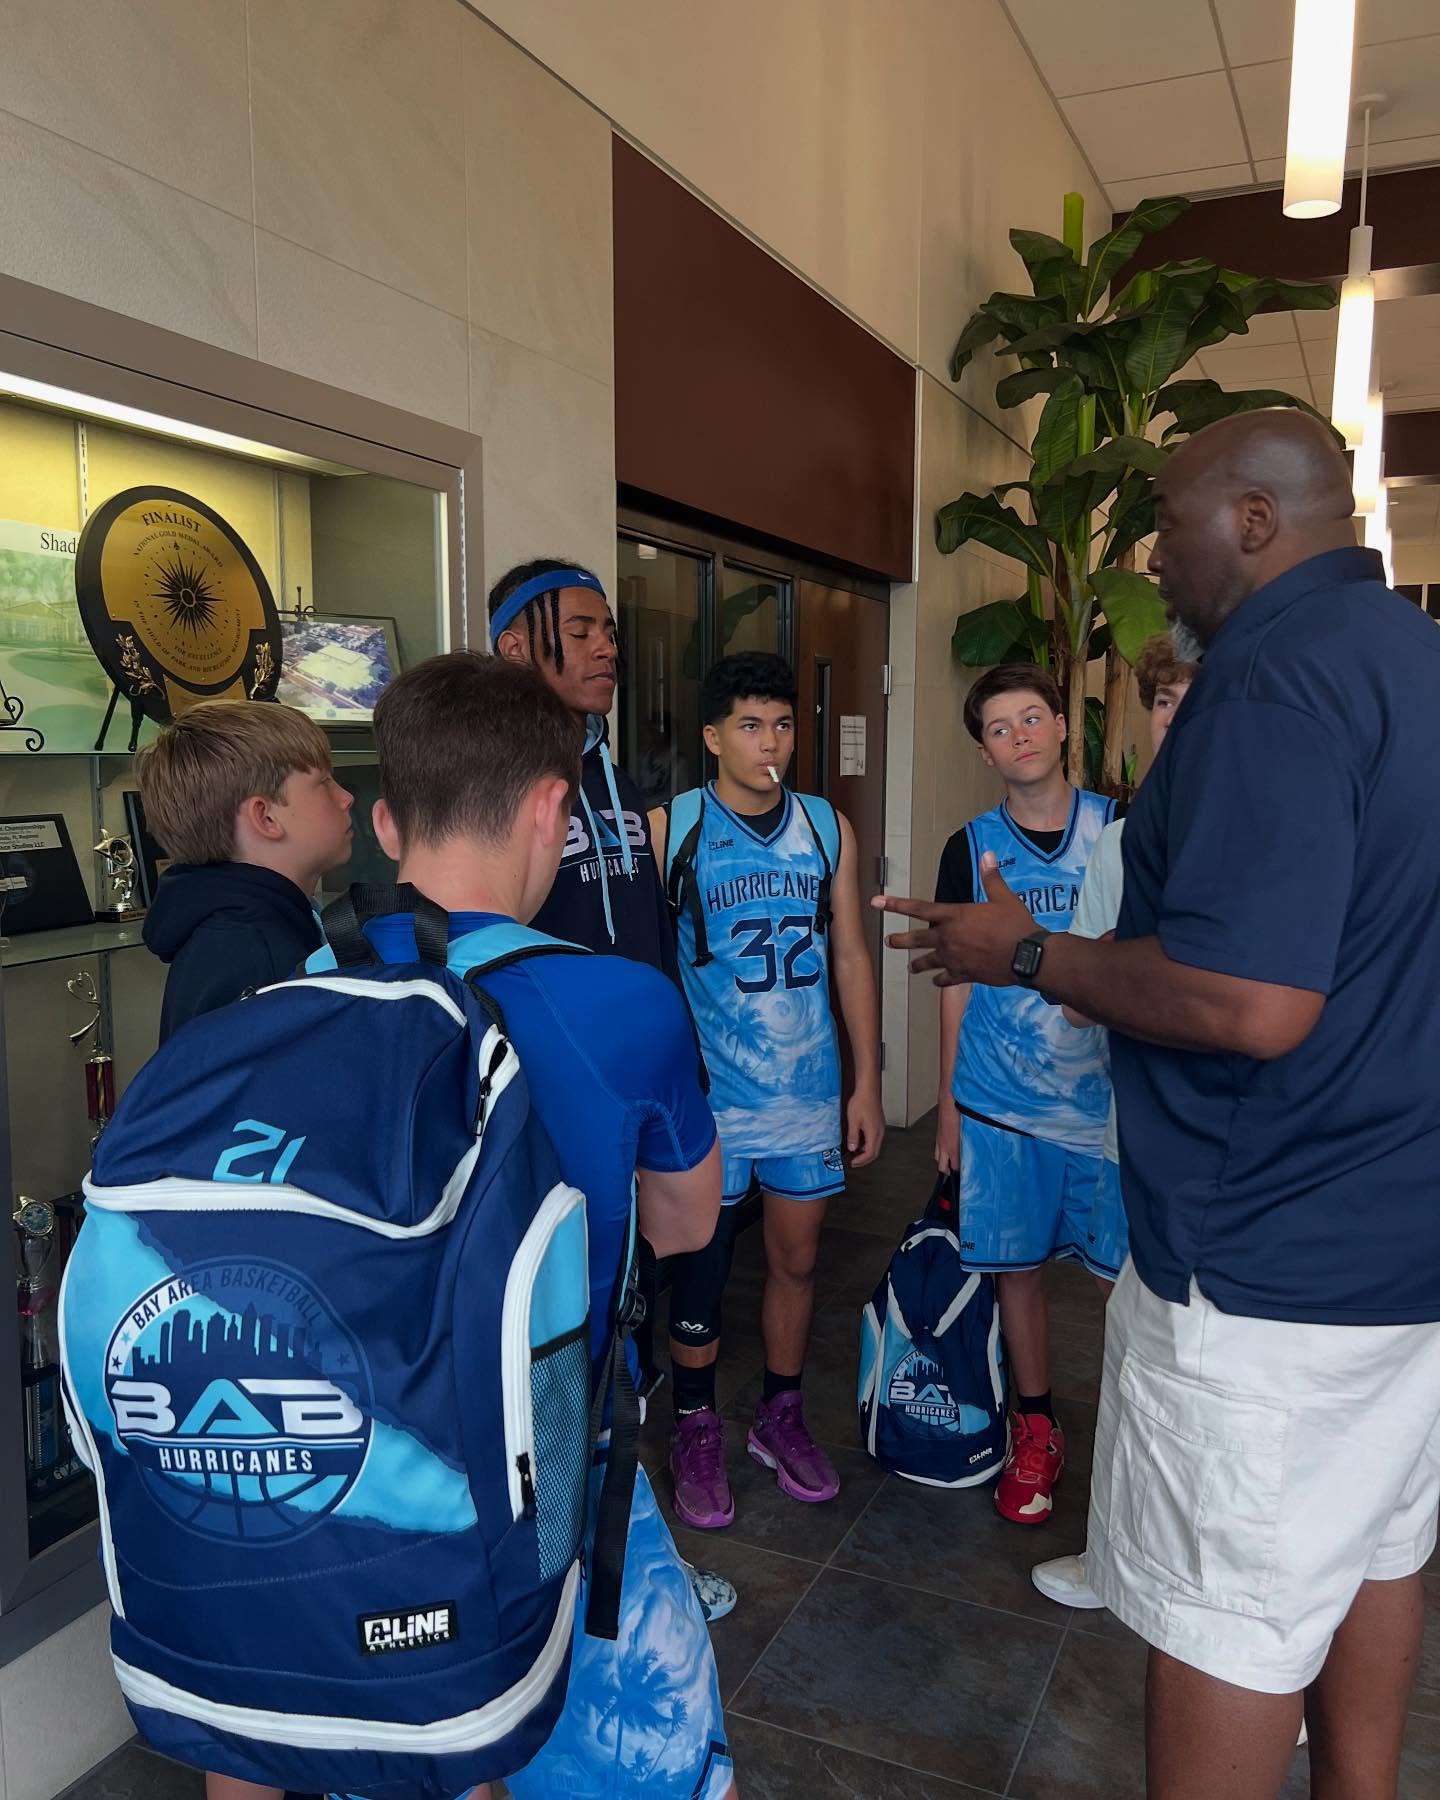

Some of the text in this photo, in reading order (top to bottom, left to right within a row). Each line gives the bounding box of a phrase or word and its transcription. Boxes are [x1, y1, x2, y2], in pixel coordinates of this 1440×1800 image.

[142, 511, 202, 533] FINALIST
[41, 532, 77, 554] Shad
[730, 915, 821, 993] 32
[213, 1119, 306, 1183] 21
[132, 1267, 322, 1330] BAY AREA BASKETBALL
[110, 1378, 364, 1436] BAB
[905, 1404, 955, 1417] HURRICANES
[159, 1446, 313, 1473] HURRICANES
[369, 1631, 450, 1652] ATHLETICS
